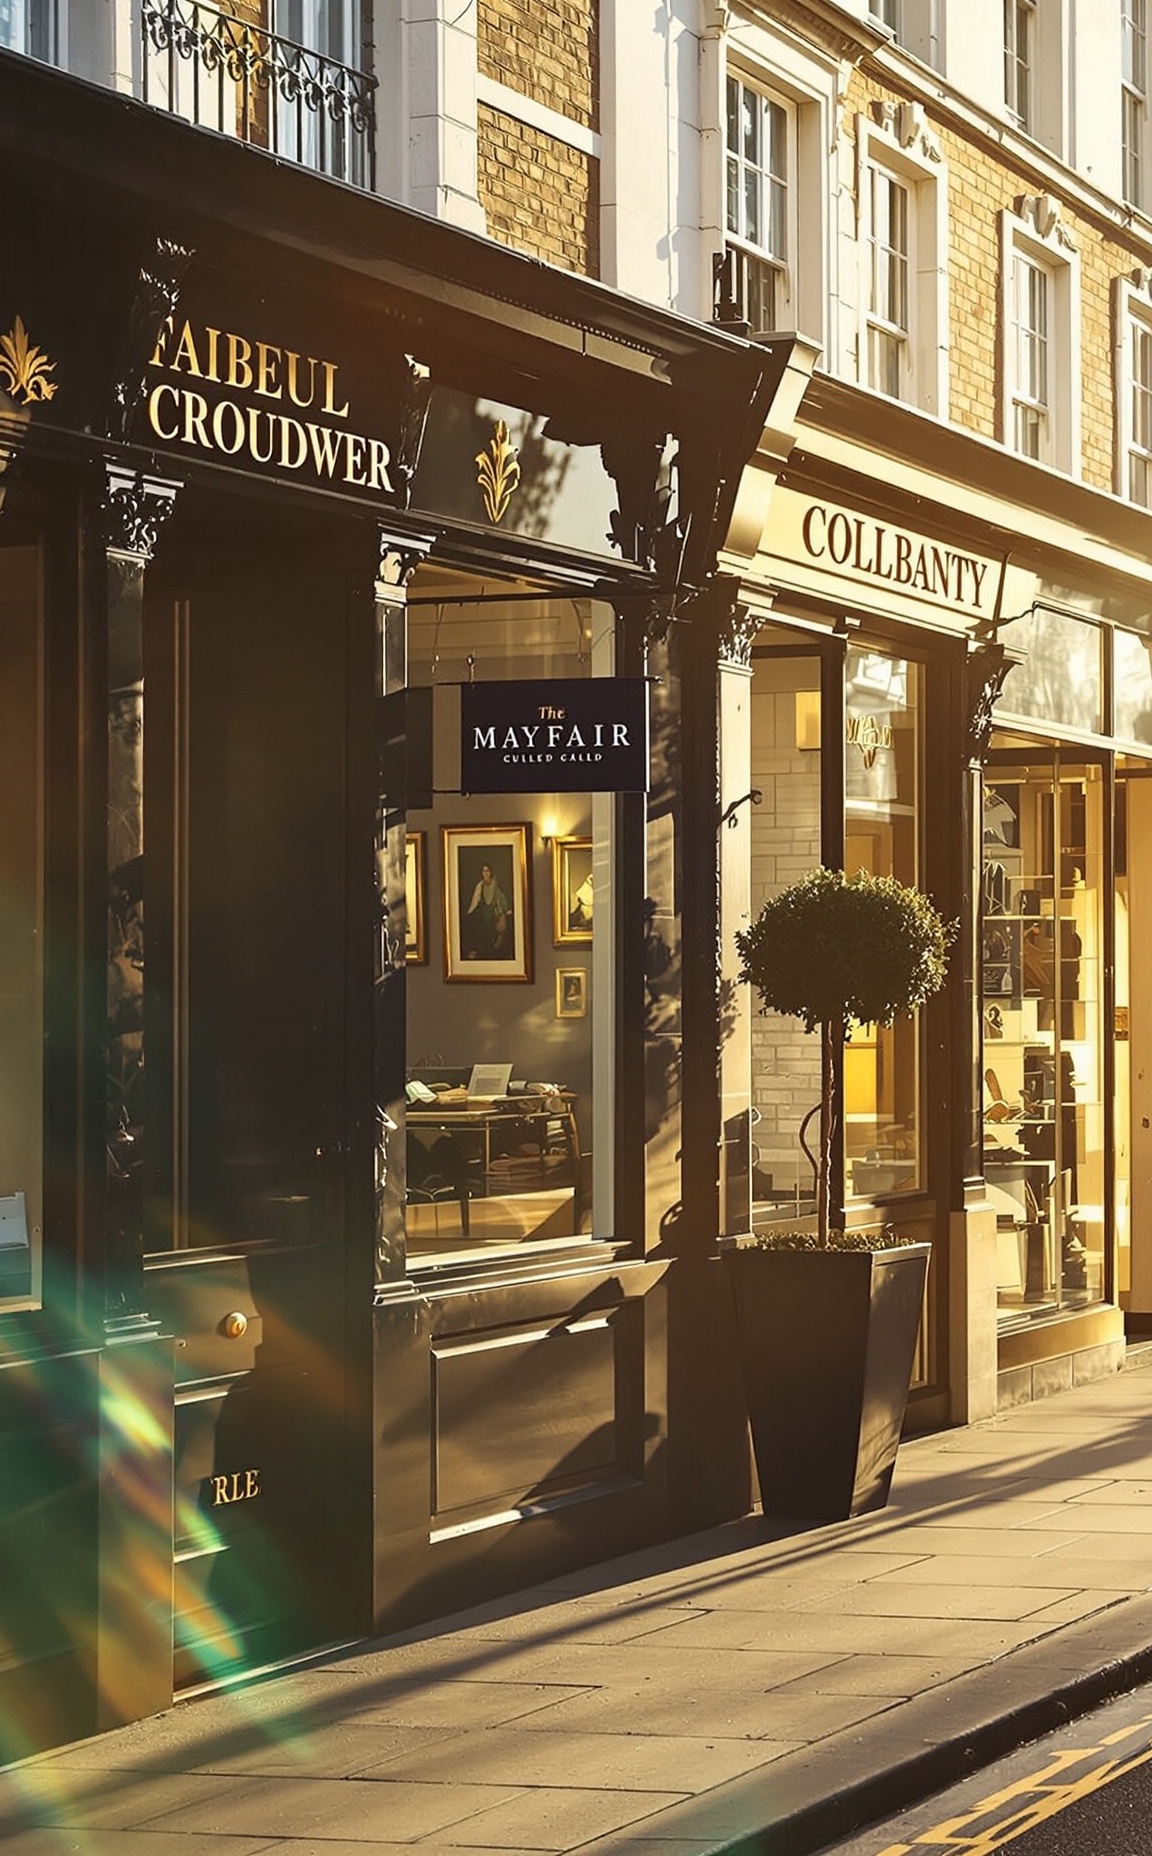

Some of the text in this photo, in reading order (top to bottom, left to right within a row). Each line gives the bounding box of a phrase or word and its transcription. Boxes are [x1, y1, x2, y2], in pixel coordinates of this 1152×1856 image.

[149, 384, 395, 493] CROUDWER
[802, 505, 988, 609] COLLBANTY
[473, 724, 630, 749] MAYFAIR
[538, 706, 566, 719] The
